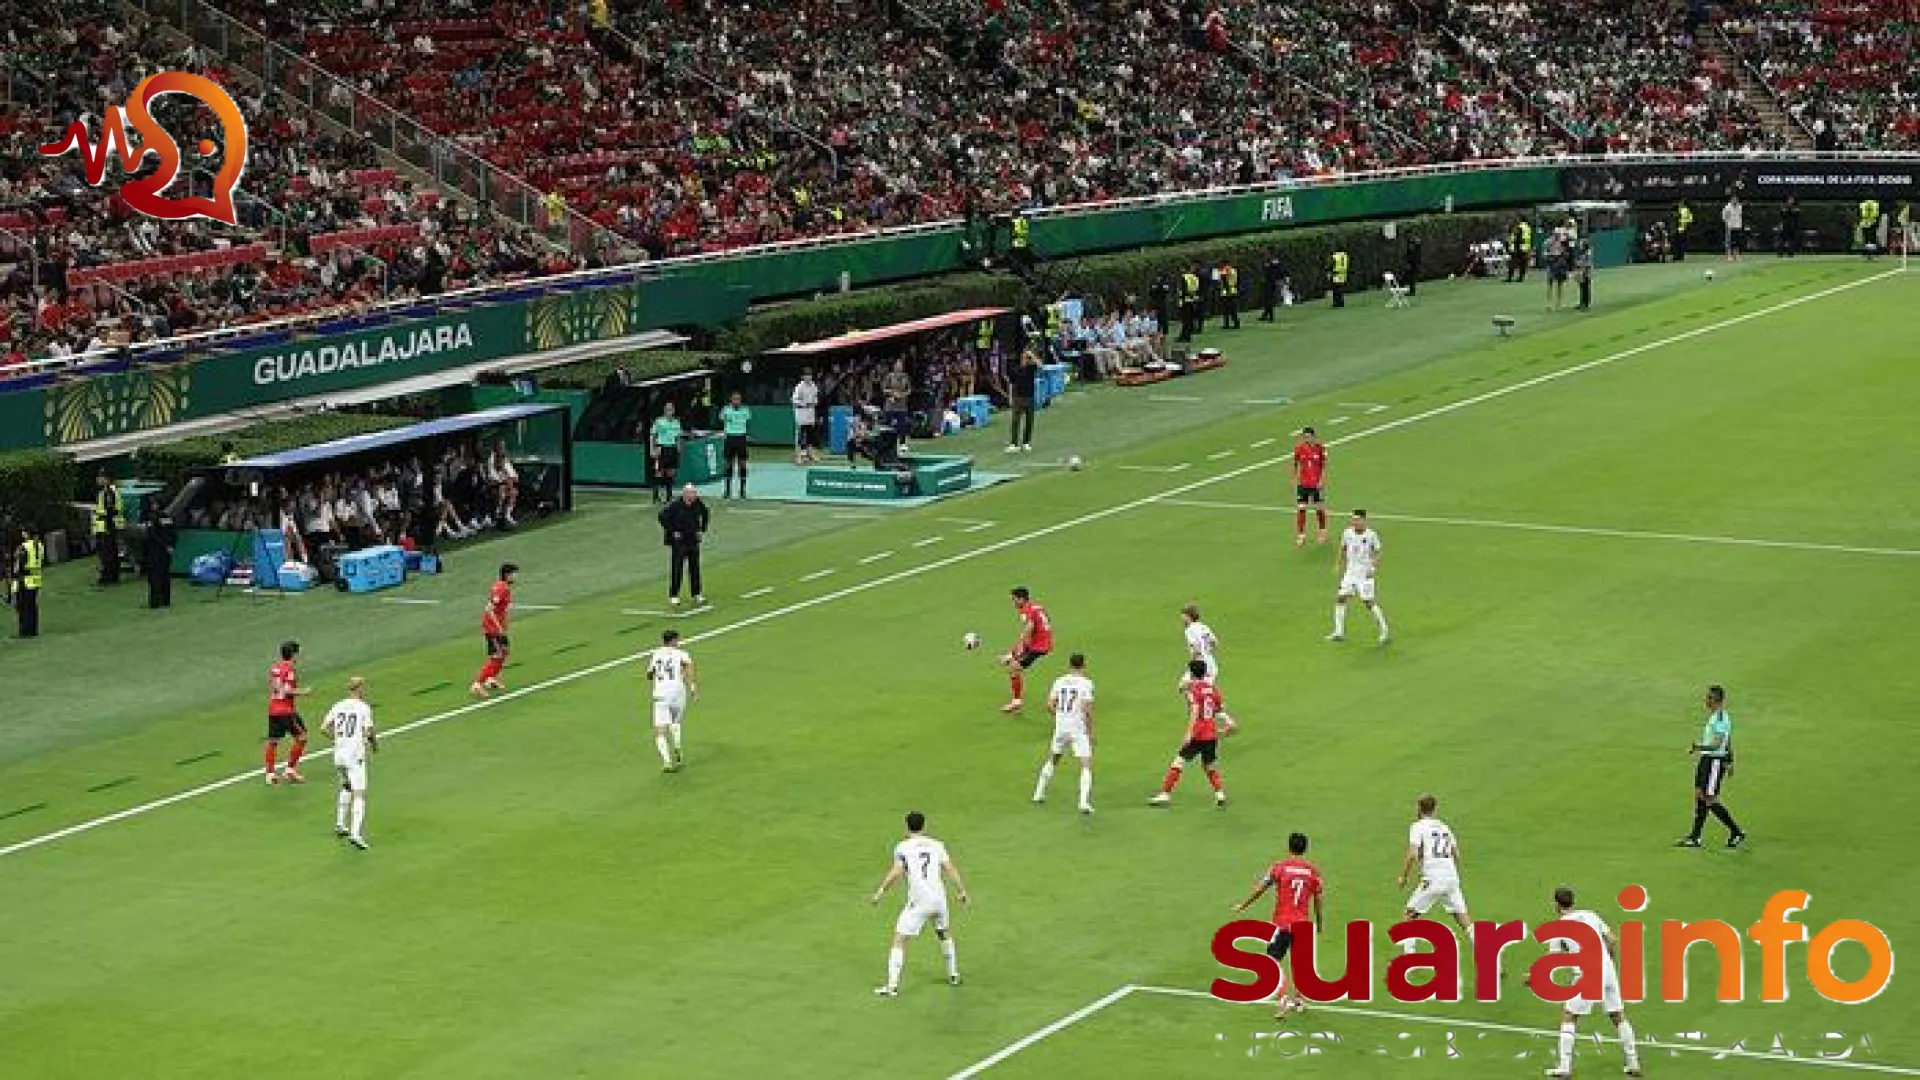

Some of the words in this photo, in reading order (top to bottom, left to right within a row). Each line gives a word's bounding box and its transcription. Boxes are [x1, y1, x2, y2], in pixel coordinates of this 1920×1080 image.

[1261, 197, 1293, 220] FIFA
[253, 322, 473, 385] GUADALAJARA
[1060, 687, 1078, 713] 17
[336, 712, 358, 738] 20
[1431, 832, 1450, 858] 22
[918, 852, 931, 880] 7
[1291, 879, 1304, 905] 7
